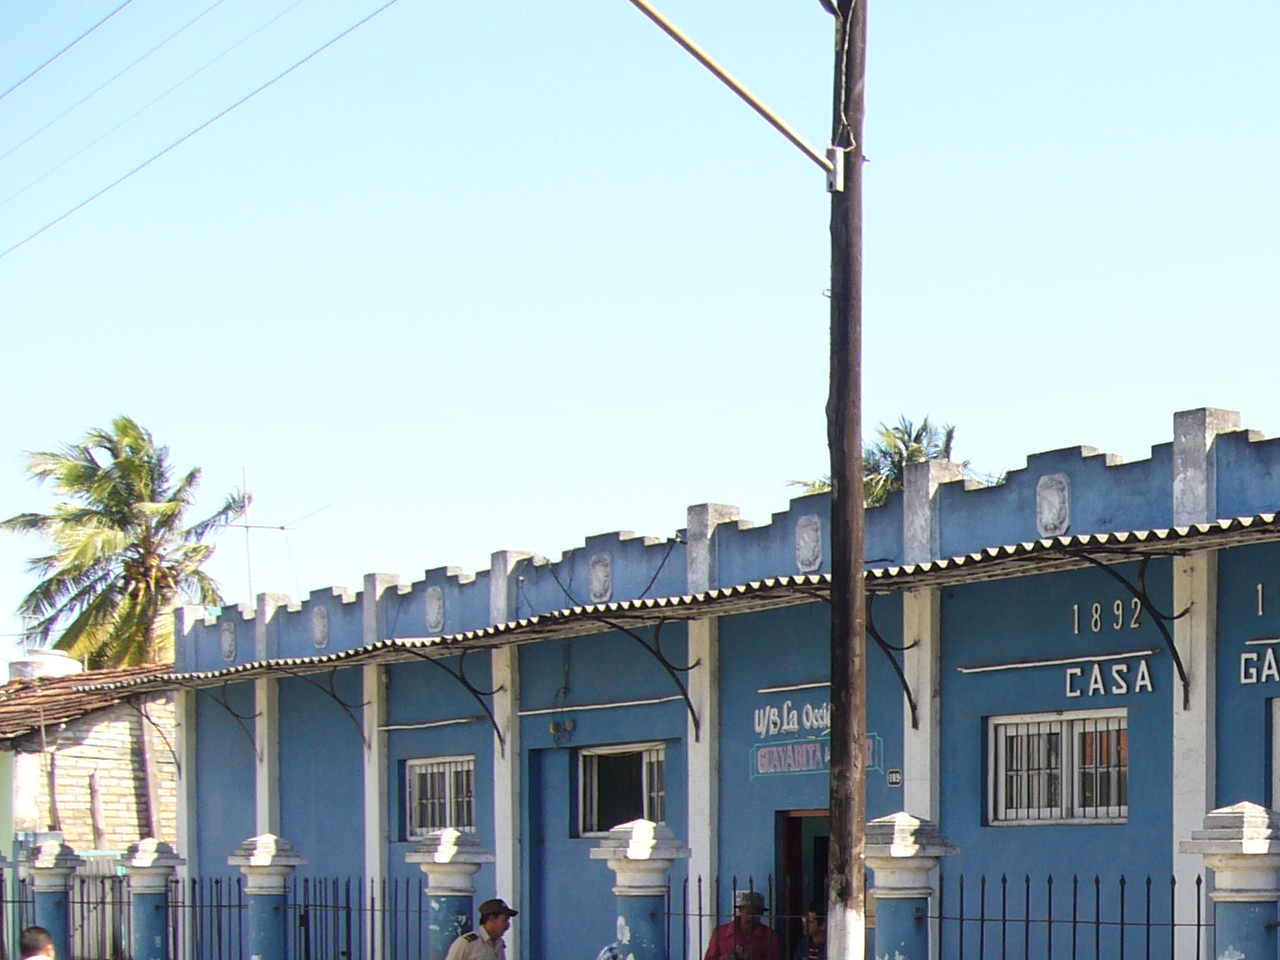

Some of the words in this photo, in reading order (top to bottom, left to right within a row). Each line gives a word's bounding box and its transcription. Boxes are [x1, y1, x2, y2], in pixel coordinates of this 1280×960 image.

[1072, 597, 1143, 635] 1892
[1065, 659, 1154, 698] CASA
[781, 700, 798, 732] La
